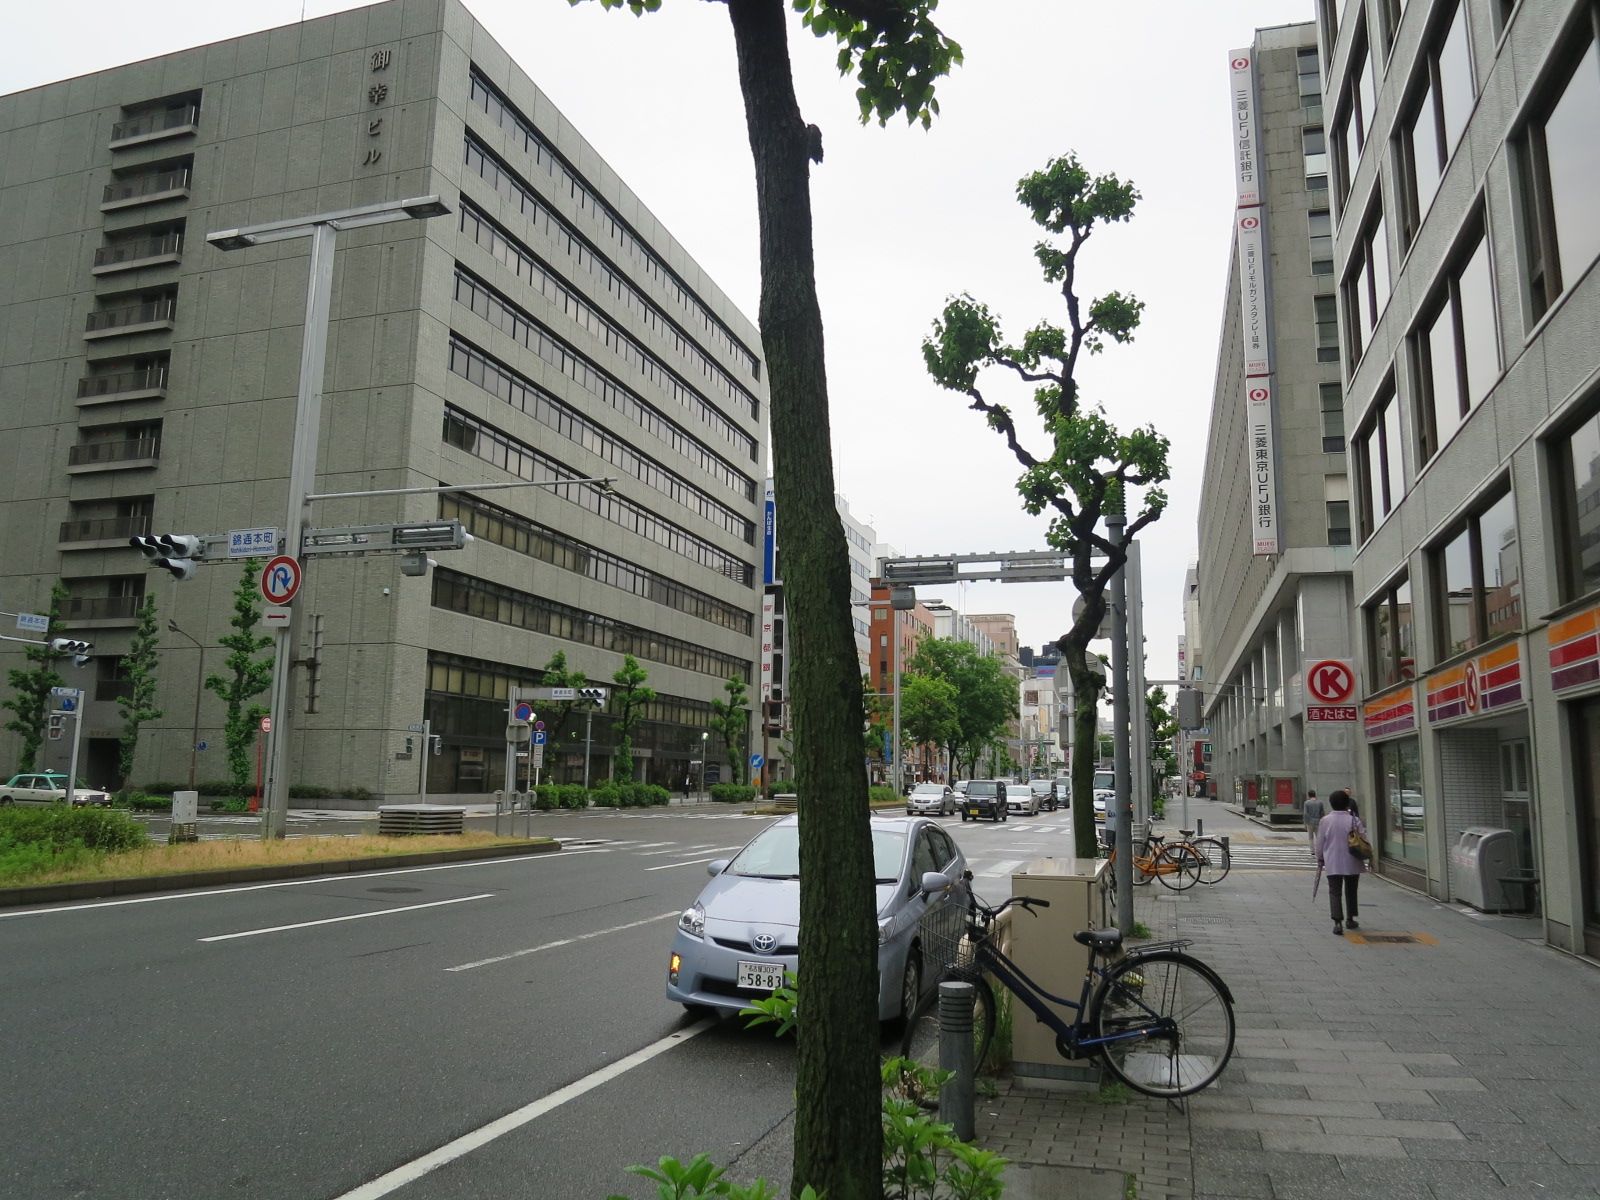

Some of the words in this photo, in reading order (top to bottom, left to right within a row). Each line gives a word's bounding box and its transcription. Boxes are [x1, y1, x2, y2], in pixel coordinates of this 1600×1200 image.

[363, 50, 391, 166] 御幸ビル
[1237, 90, 1253, 182] 三菱UFJ信託銀行
[1255, 424, 1271, 528] 三菱東京UFJ銀行
[232, 532, 273, 545] 錦通本町
[535, 732, 544, 743] P
[747, 973, 781, 987] 58-83
